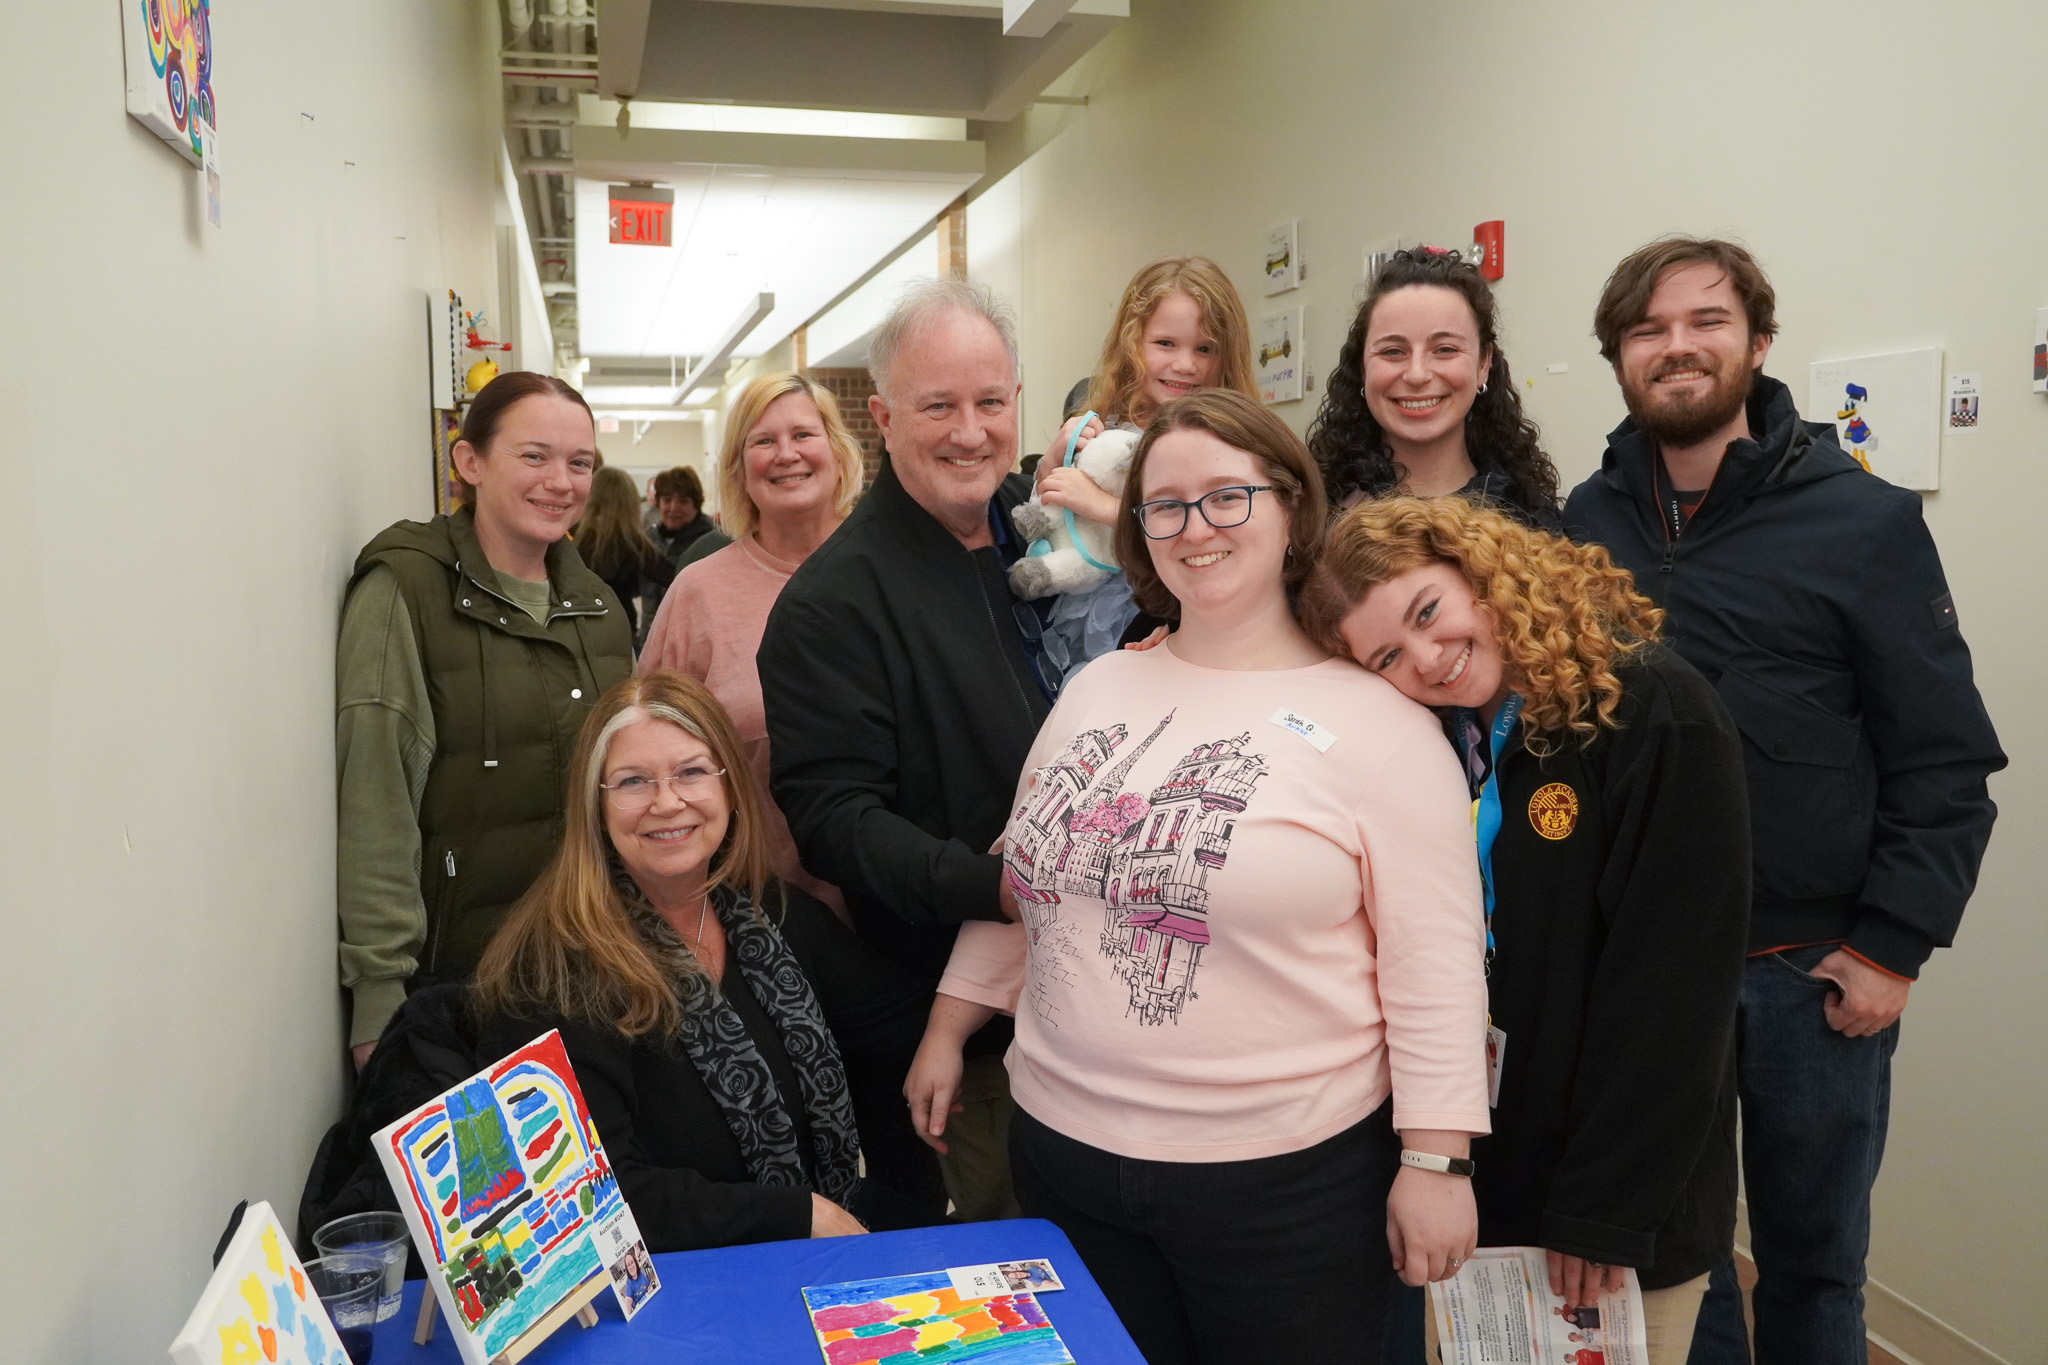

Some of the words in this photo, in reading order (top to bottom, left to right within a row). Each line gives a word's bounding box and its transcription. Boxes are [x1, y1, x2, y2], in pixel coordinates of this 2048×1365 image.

[620, 207, 665, 243] EXIT
[1283, 713, 1304, 727] Sarah
[1495, 694, 1517, 737] Loyola
[1530, 786, 1554, 813] LOYOLA
[1555, 785, 1578, 816] ACADEMY
[600, 1221, 614, 1236] Auction
[614, 1210, 625, 1222] #047
[614, 1246, 627, 1258] Sarah
[1449, 1287, 1457, 1309] pieces:
[1455, 1321, 1464, 1351] purchase
